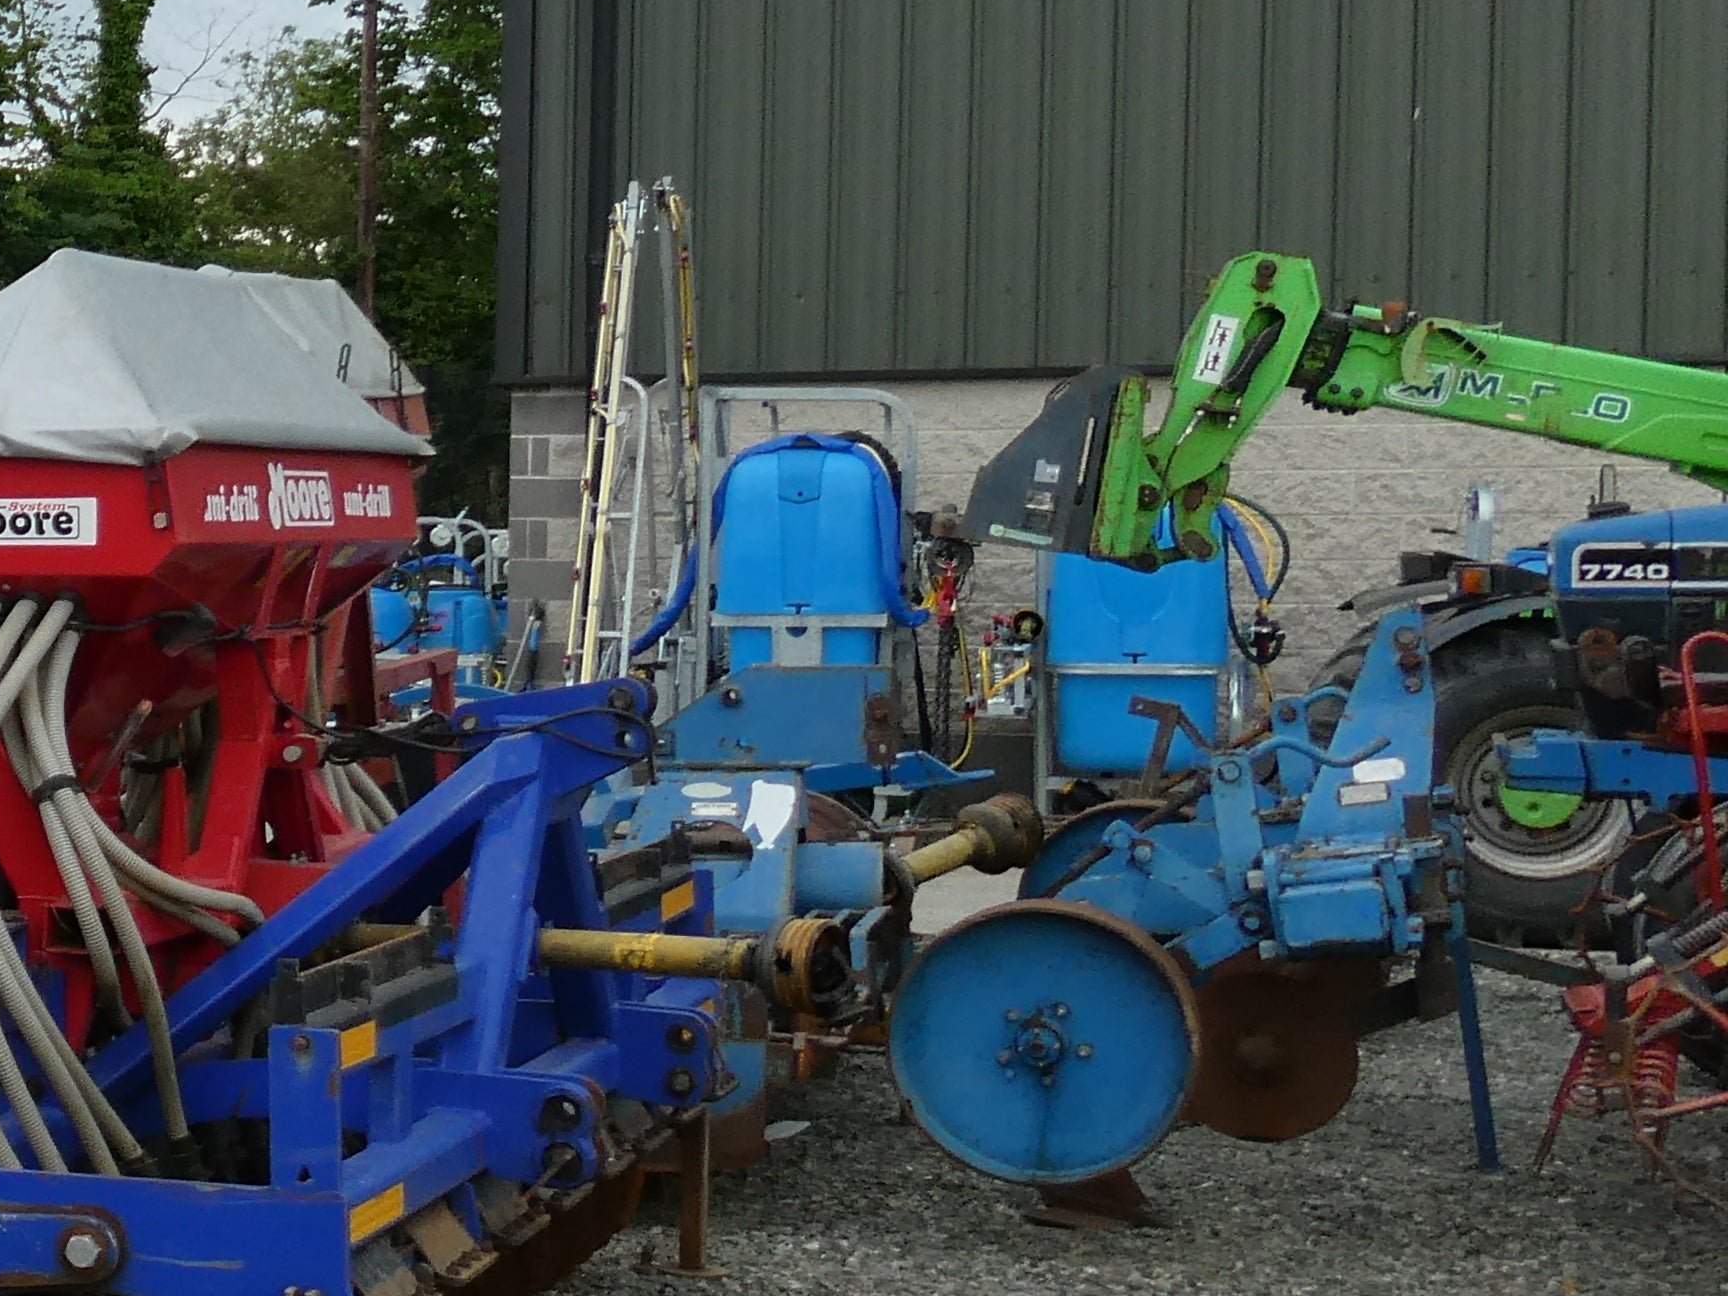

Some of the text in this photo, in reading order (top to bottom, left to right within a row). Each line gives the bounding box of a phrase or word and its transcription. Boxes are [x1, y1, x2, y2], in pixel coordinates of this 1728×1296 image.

[267, 461, 331, 530] Moore
[8, 501, 67, 514] System
[1580, 563, 1670, 581] 7740
